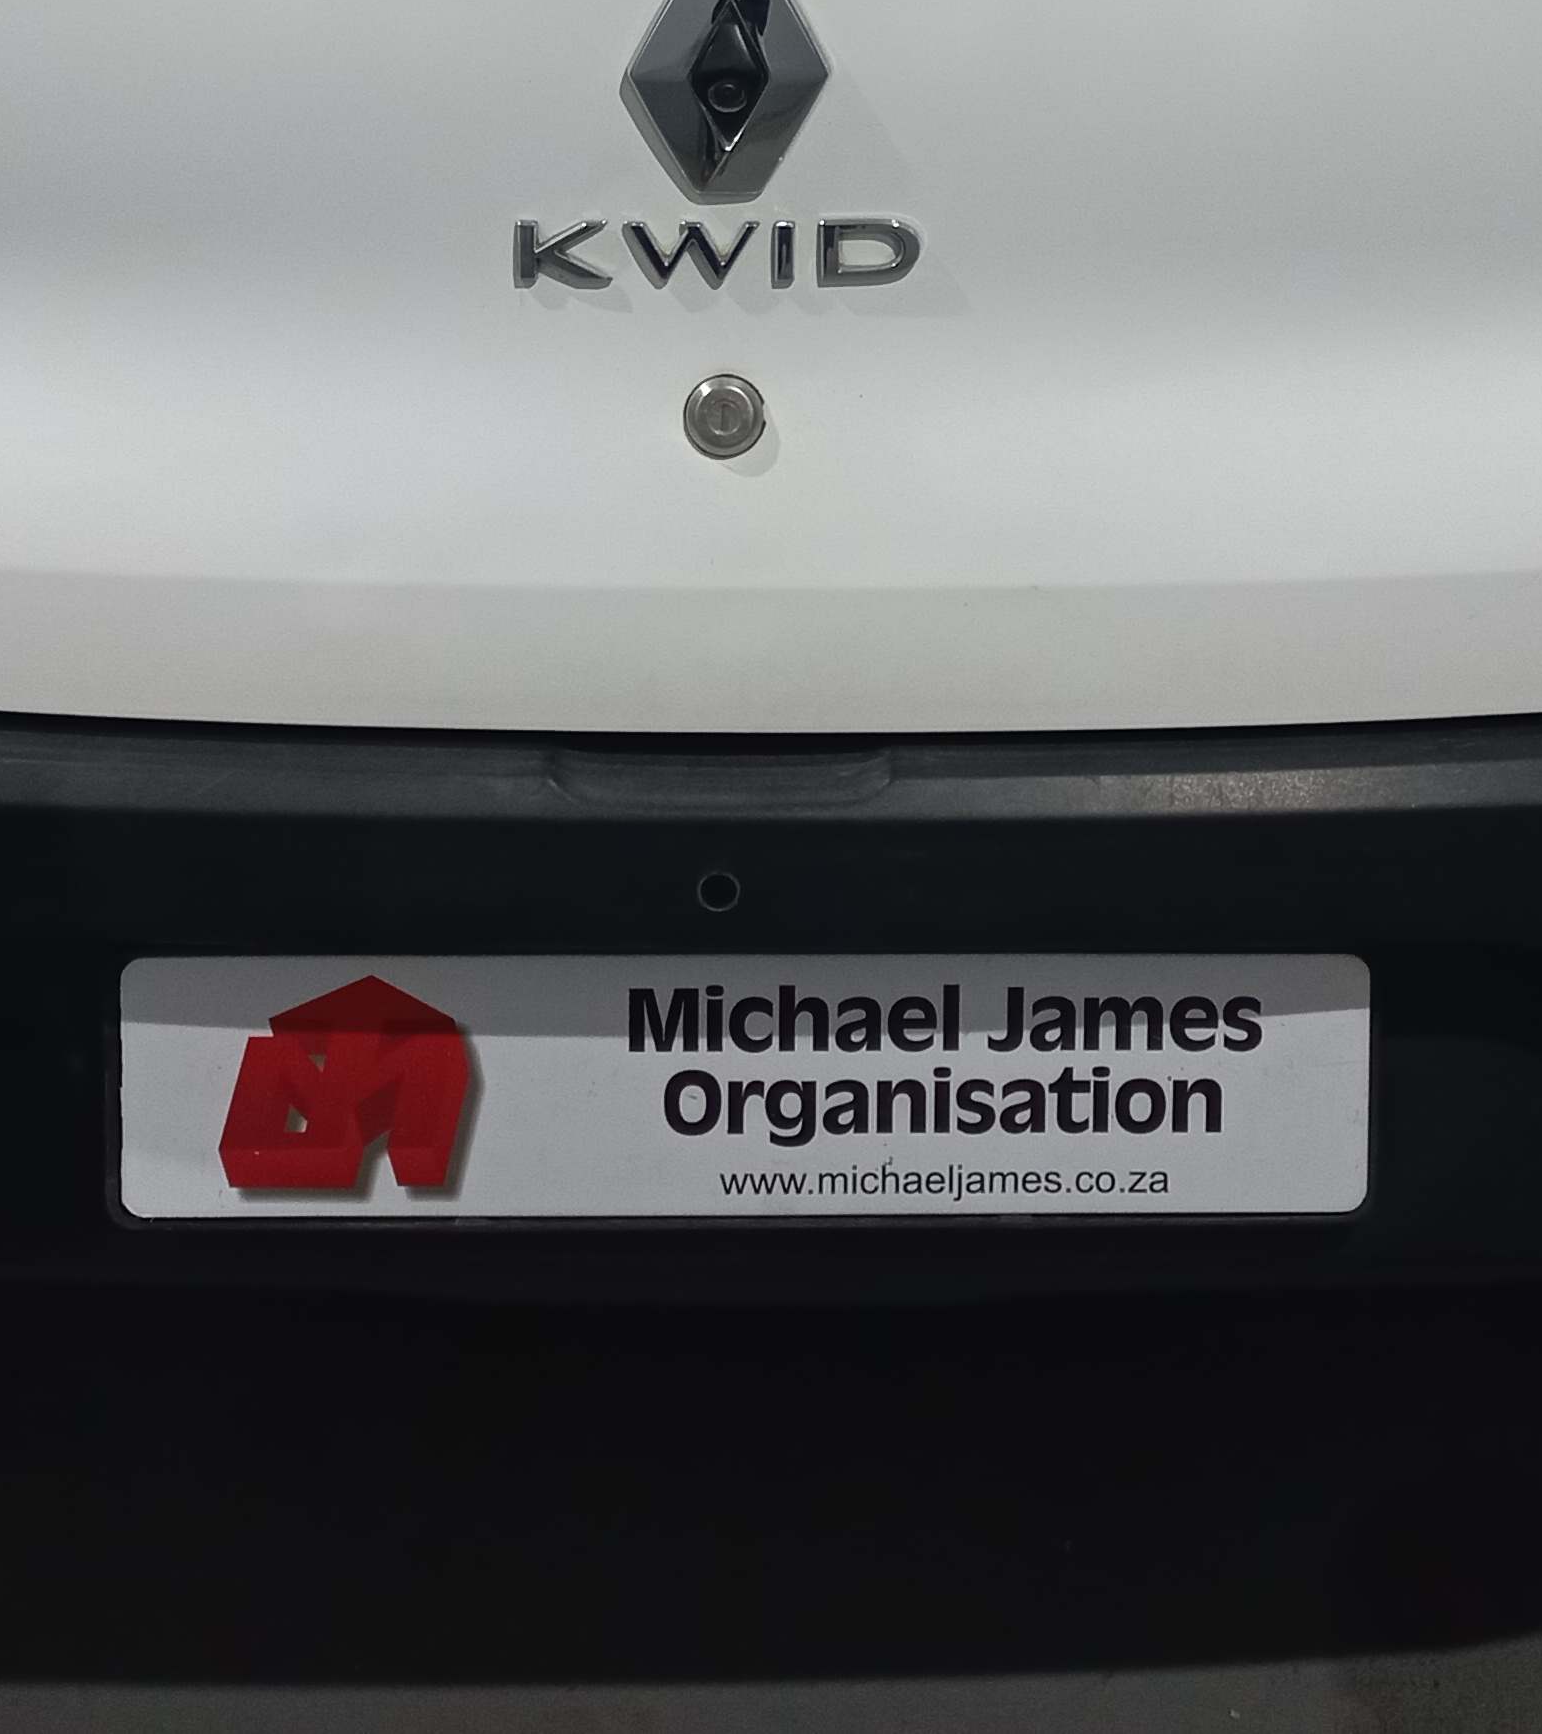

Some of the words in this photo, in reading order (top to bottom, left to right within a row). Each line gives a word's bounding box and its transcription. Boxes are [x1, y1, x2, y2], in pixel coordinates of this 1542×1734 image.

[512, 218, 921, 291] KWID
[628, 984, 961, 1053] Michael
[987, 986, 1263, 1053] James
[663, 1066, 1224, 1148] Organisation
[720, 1164, 1170, 1201] www.michaeljames.co.za
